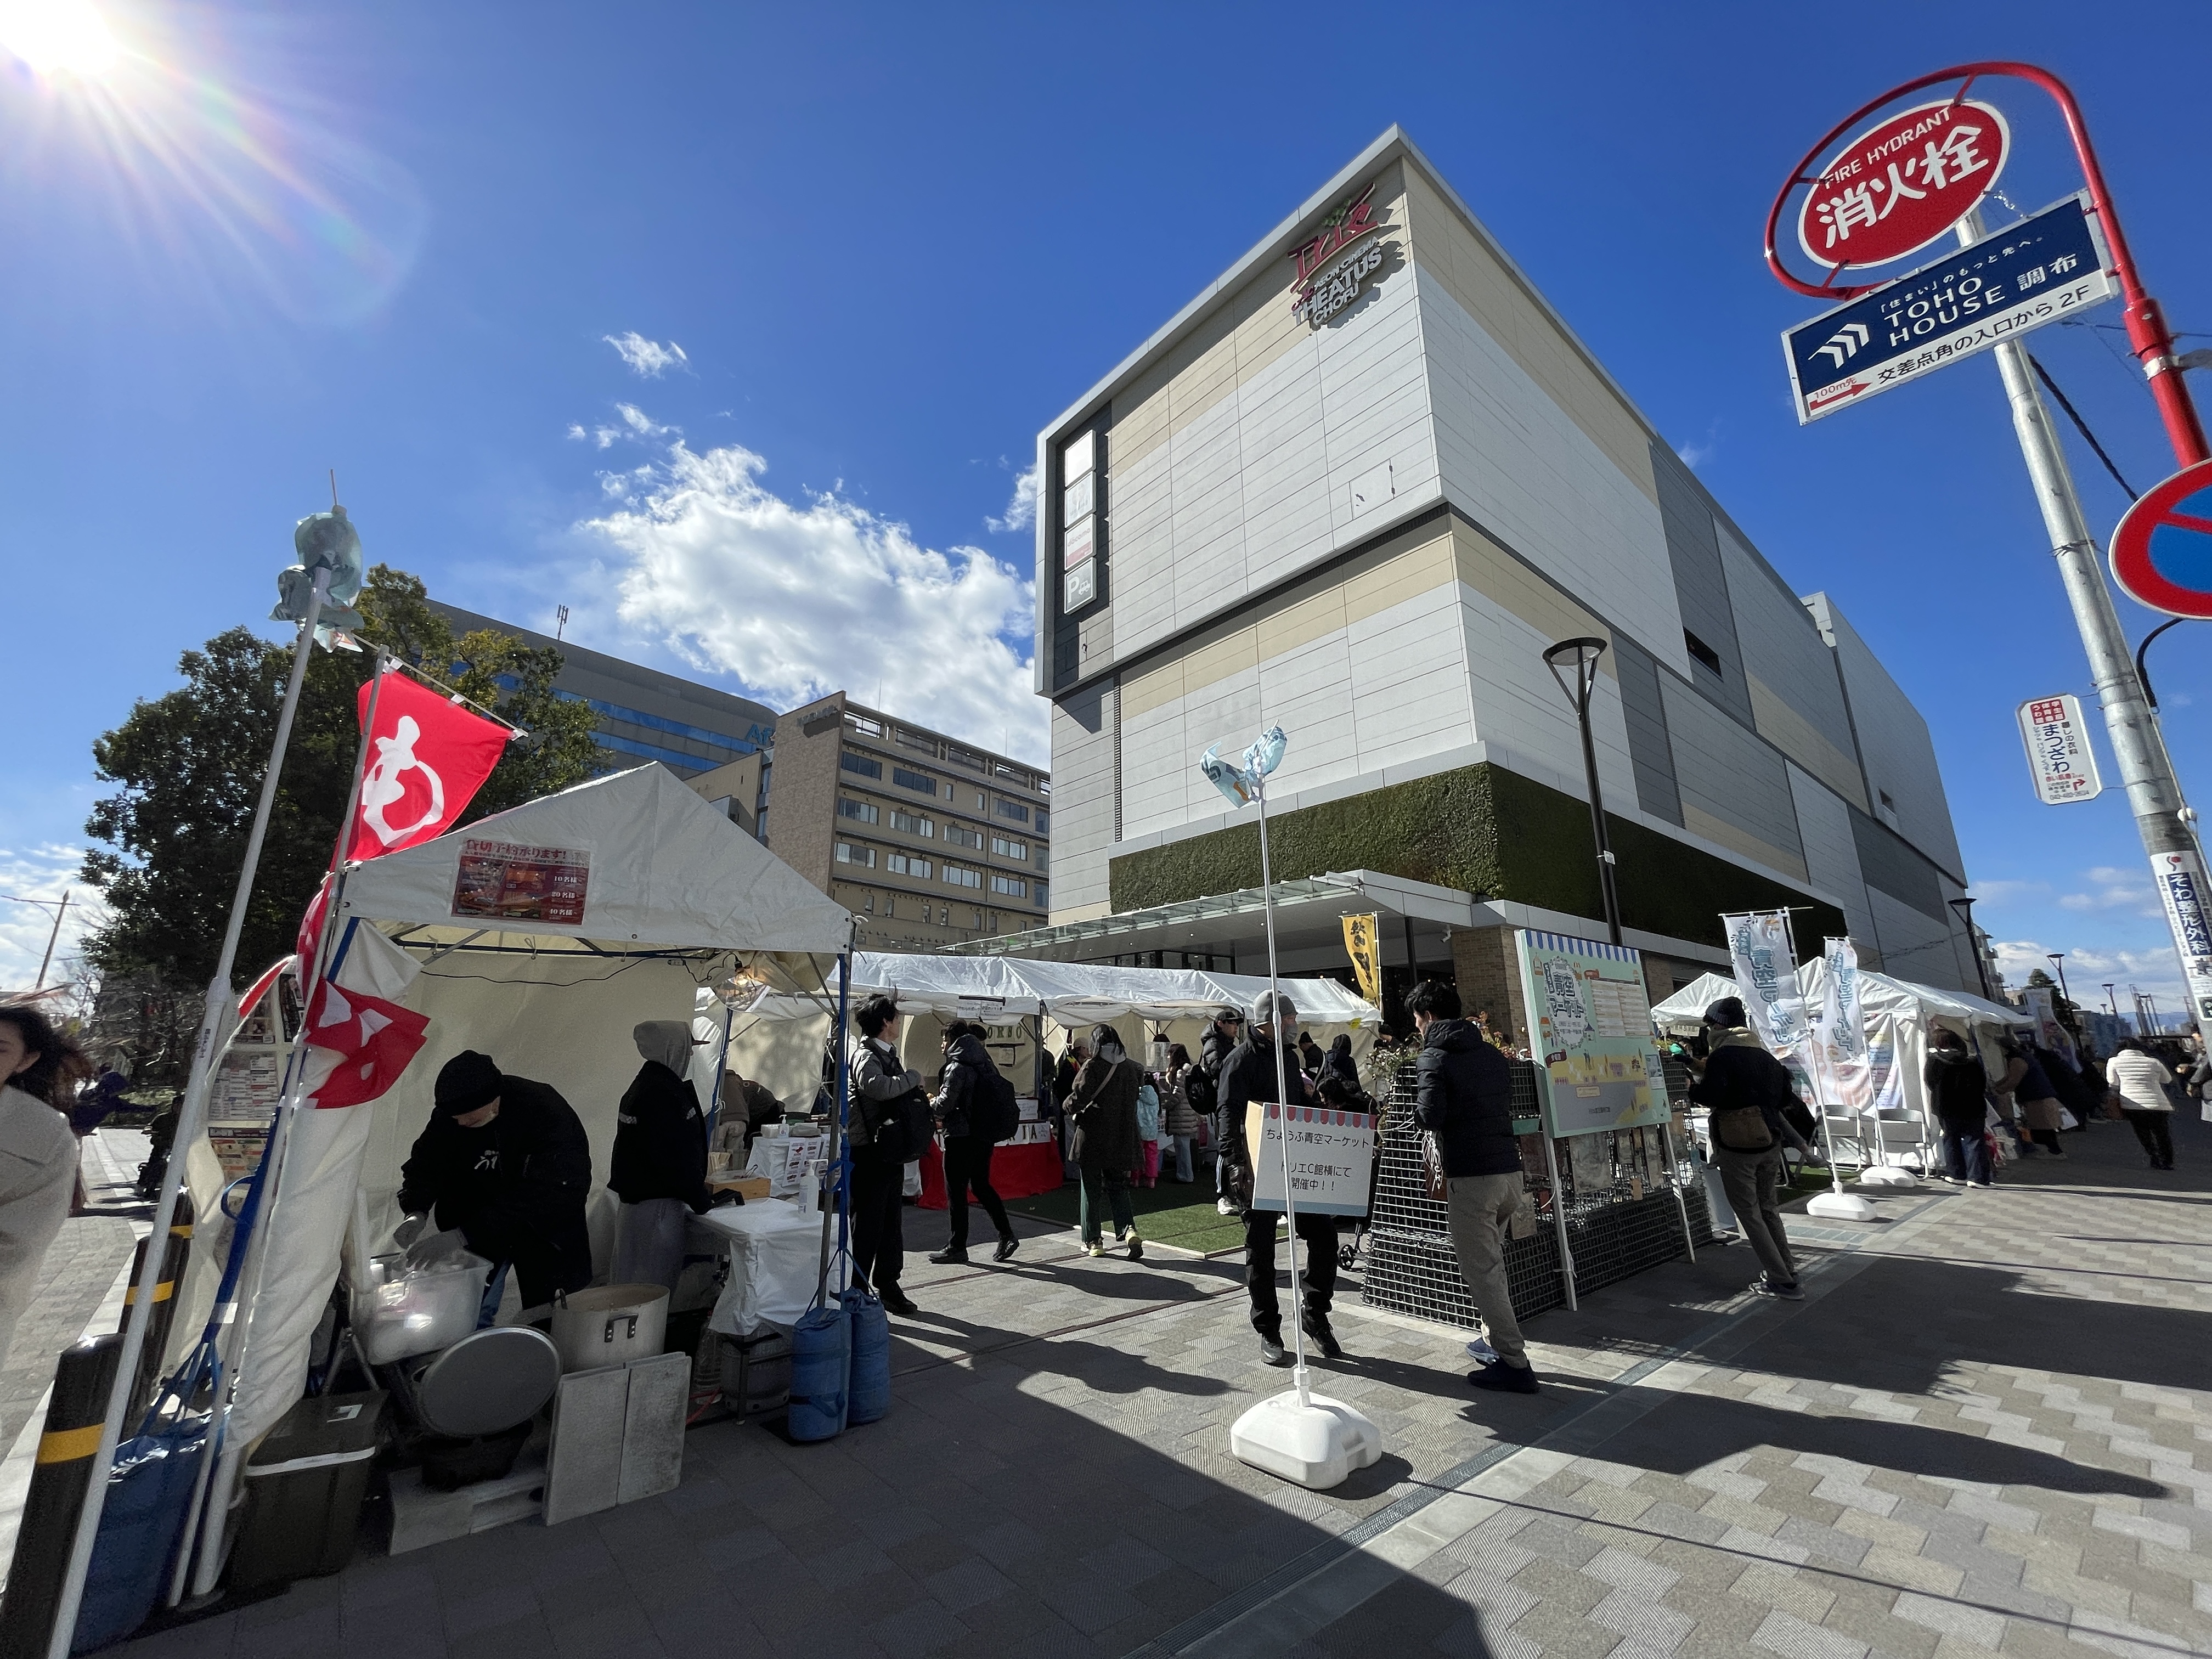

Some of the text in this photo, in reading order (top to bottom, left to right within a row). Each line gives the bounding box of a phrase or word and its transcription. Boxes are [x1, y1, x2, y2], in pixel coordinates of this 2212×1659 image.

[1825, 108, 1950, 190] FIRE HYDRANT
[1815, 126, 1988, 249] 消火栓
[1292, 247, 1382, 325] THEATUS
[1313, 283, 1359, 325] CHOFU
[1884, 276, 1982, 328] TOHO
[1889, 254, 2077, 347] HOUSE 調布
[1878, 285, 2090, 383] 交差点角の入口から 2F
[1814, 377, 1857, 399] 100m先
[1068, 527, 1091, 547] docomo
[1068, 575, 1079, 603] P
[2042, 724, 2070, 774] まつざわ
[1266, 1128, 1369, 1148] ちょうふ青空マーケット
